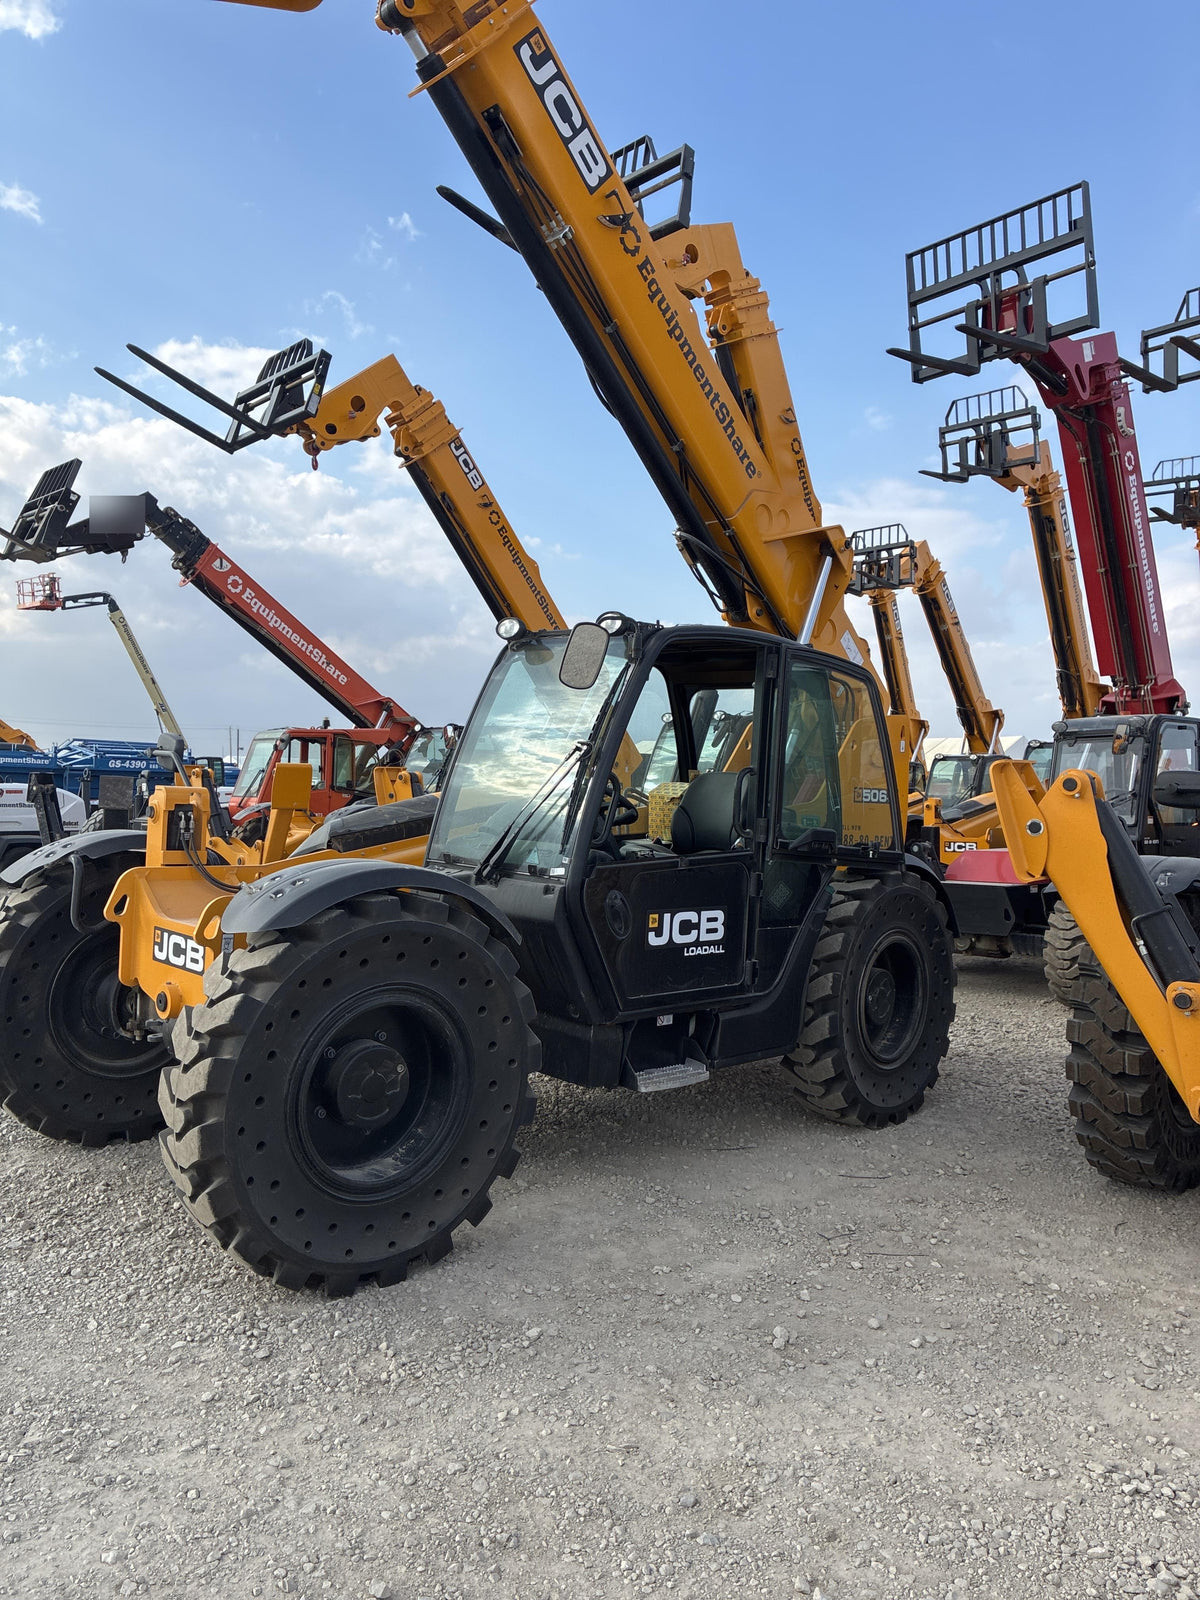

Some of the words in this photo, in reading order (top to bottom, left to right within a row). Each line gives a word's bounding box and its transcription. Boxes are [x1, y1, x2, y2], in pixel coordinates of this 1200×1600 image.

[519, 42, 607, 187] JCB
[637, 255, 758, 479] EquipmentShare
[450, 441, 483, 490] JCB
[1060, 500, 1073, 548] JCB
[1128, 473, 1160, 636] EquipmentShare
[122, 624, 150, 674] EquipmentShare
[241, 587, 348, 685] EquipmentShare
[108, 760, 147, 769] GS-4390
[945, 842, 977, 852] JCB
[154, 931, 205, 972] JCB
[647, 910, 725, 946] JCB
[684, 944, 725, 957] LOADALL
